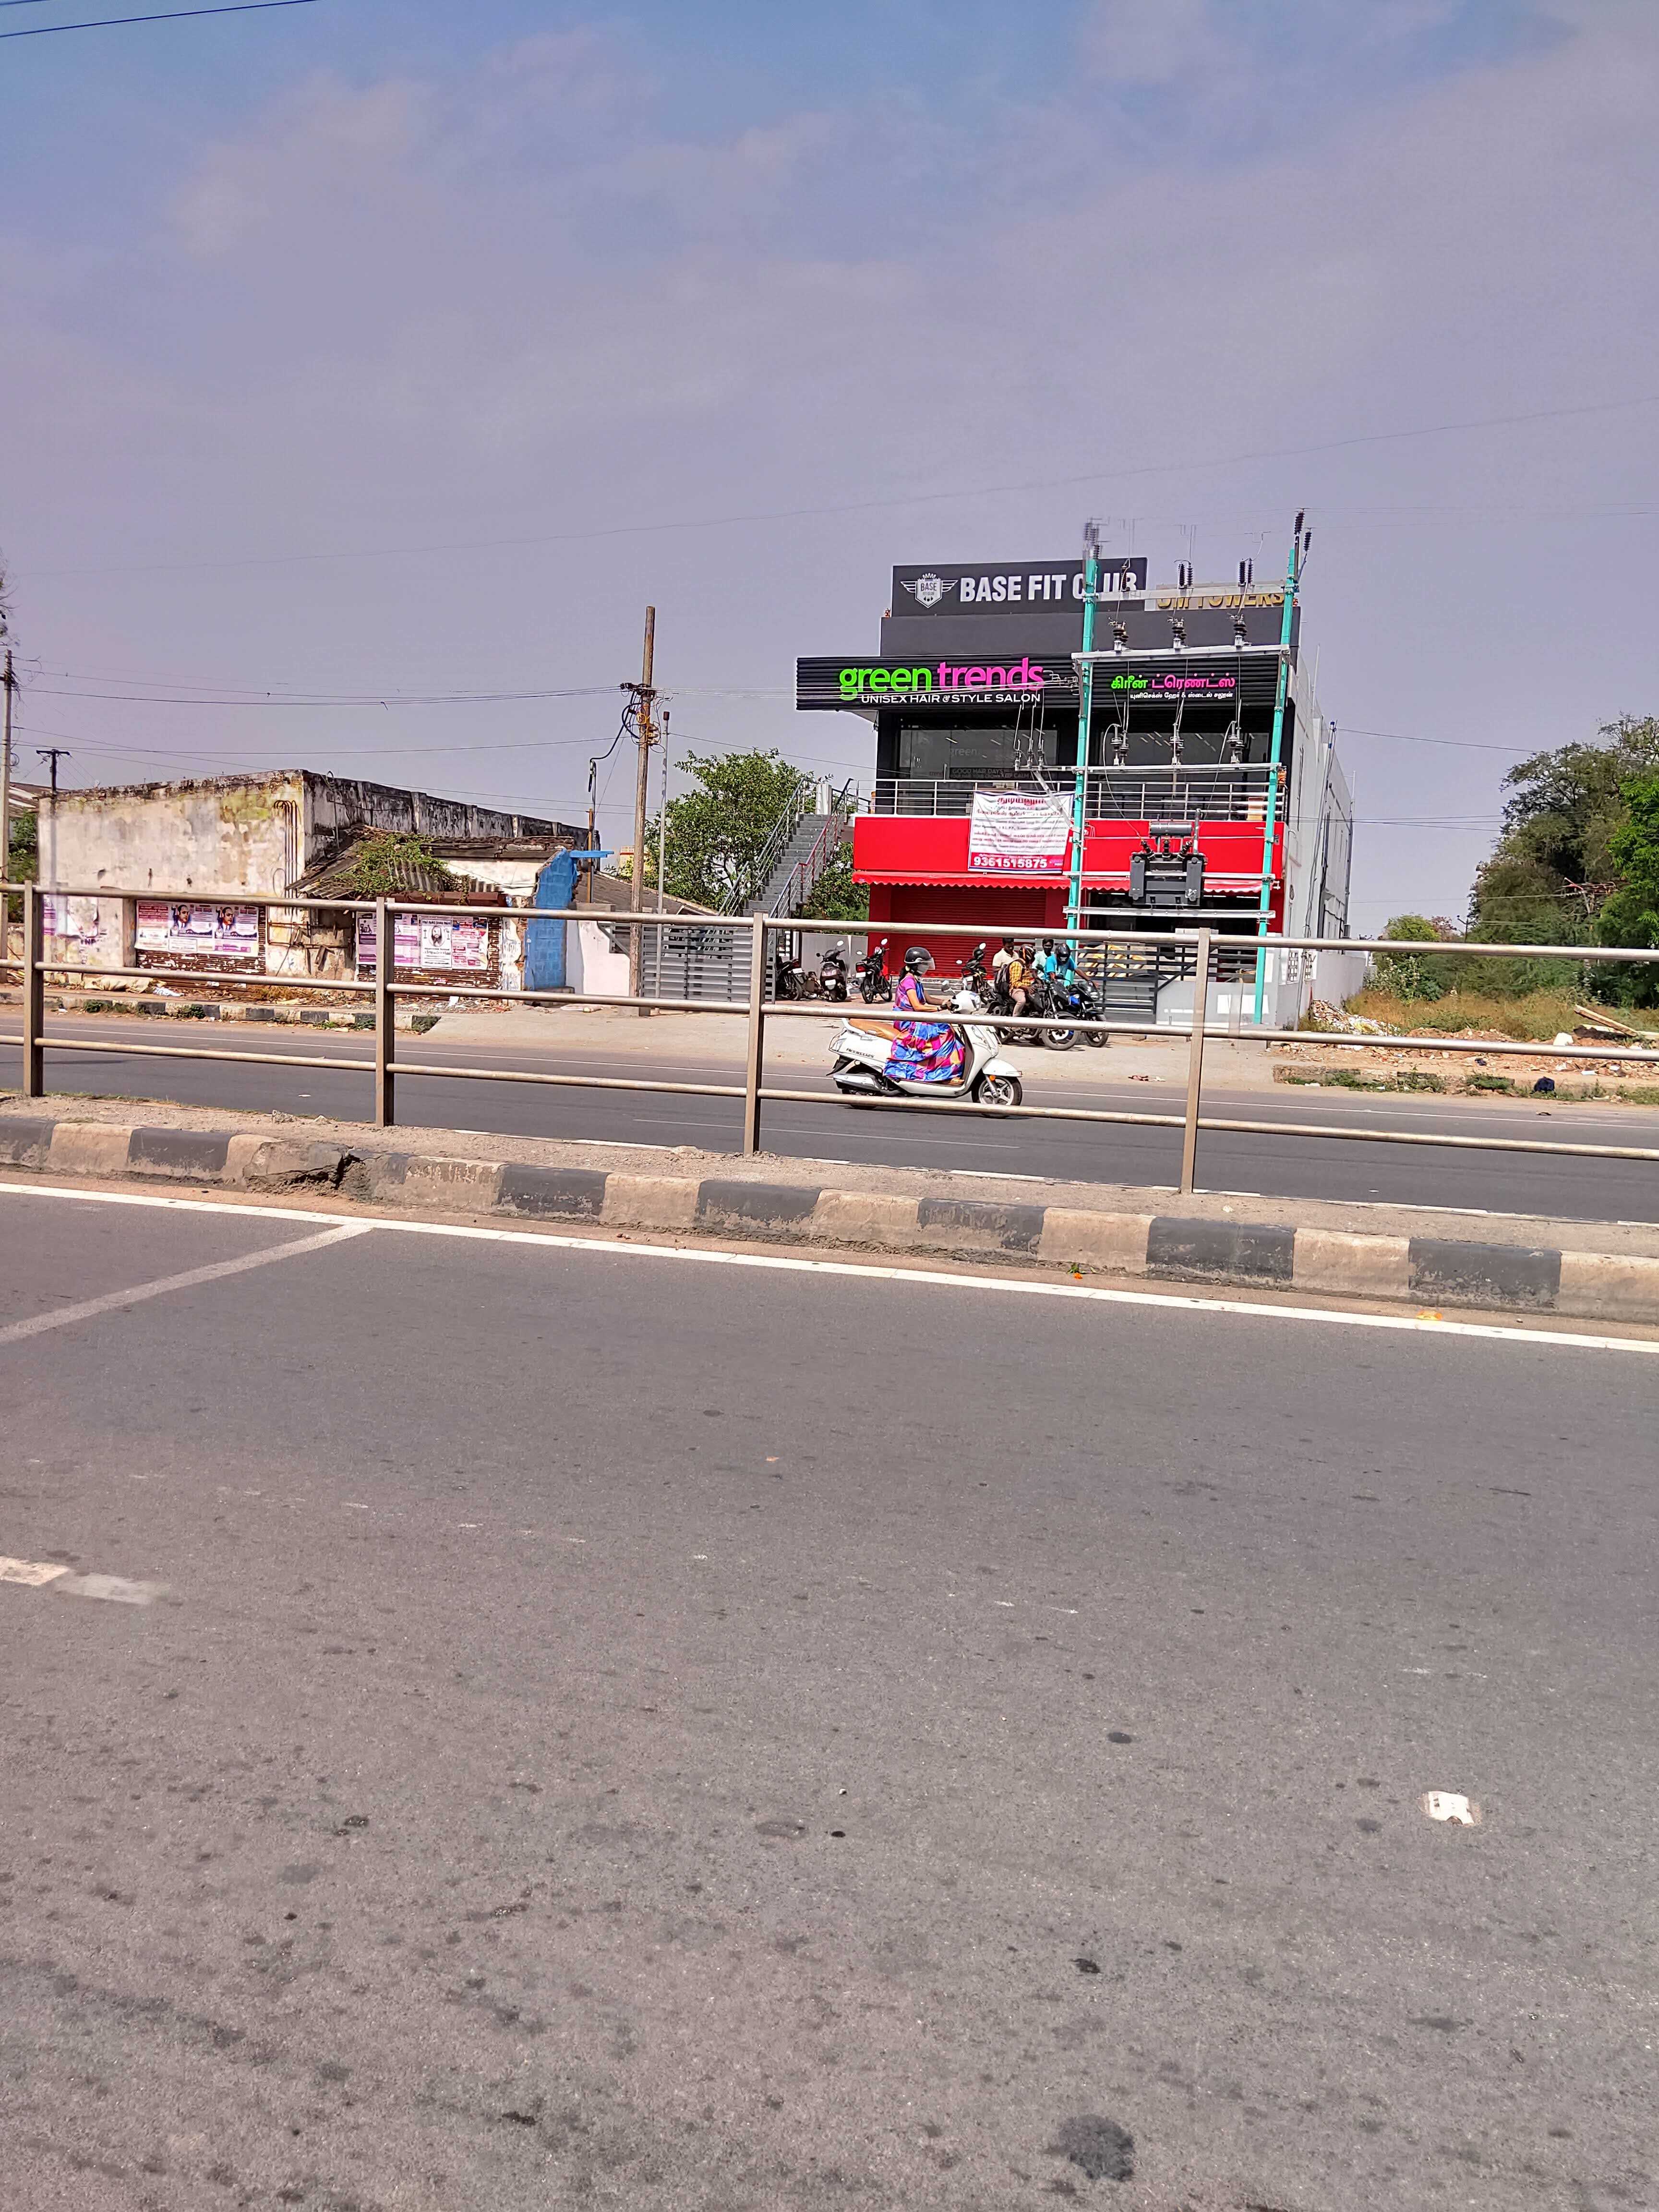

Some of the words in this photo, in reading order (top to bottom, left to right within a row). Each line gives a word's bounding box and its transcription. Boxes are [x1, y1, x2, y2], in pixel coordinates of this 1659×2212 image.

[921, 582, 938, 591] BASE
[960, 576, 1022, 602] BASE
[1028, 574, 1066, 601] FIT
[839, 667, 931, 700] green
[937, 657, 1045, 692] trends
[1110, 674, 1149, 689] கிரீன்
[1152, 672, 1236, 690] ட்ரெண்ட்ஸ்
[861, 695, 907, 703] UNISEX
[910, 694, 940, 703] HAIR
[942, 695, 950, 703] &
[951, 694, 993, 703] STYLE
[995, 693, 1041, 702] SALON
[974, 856, 1047, 868] 9361515875
